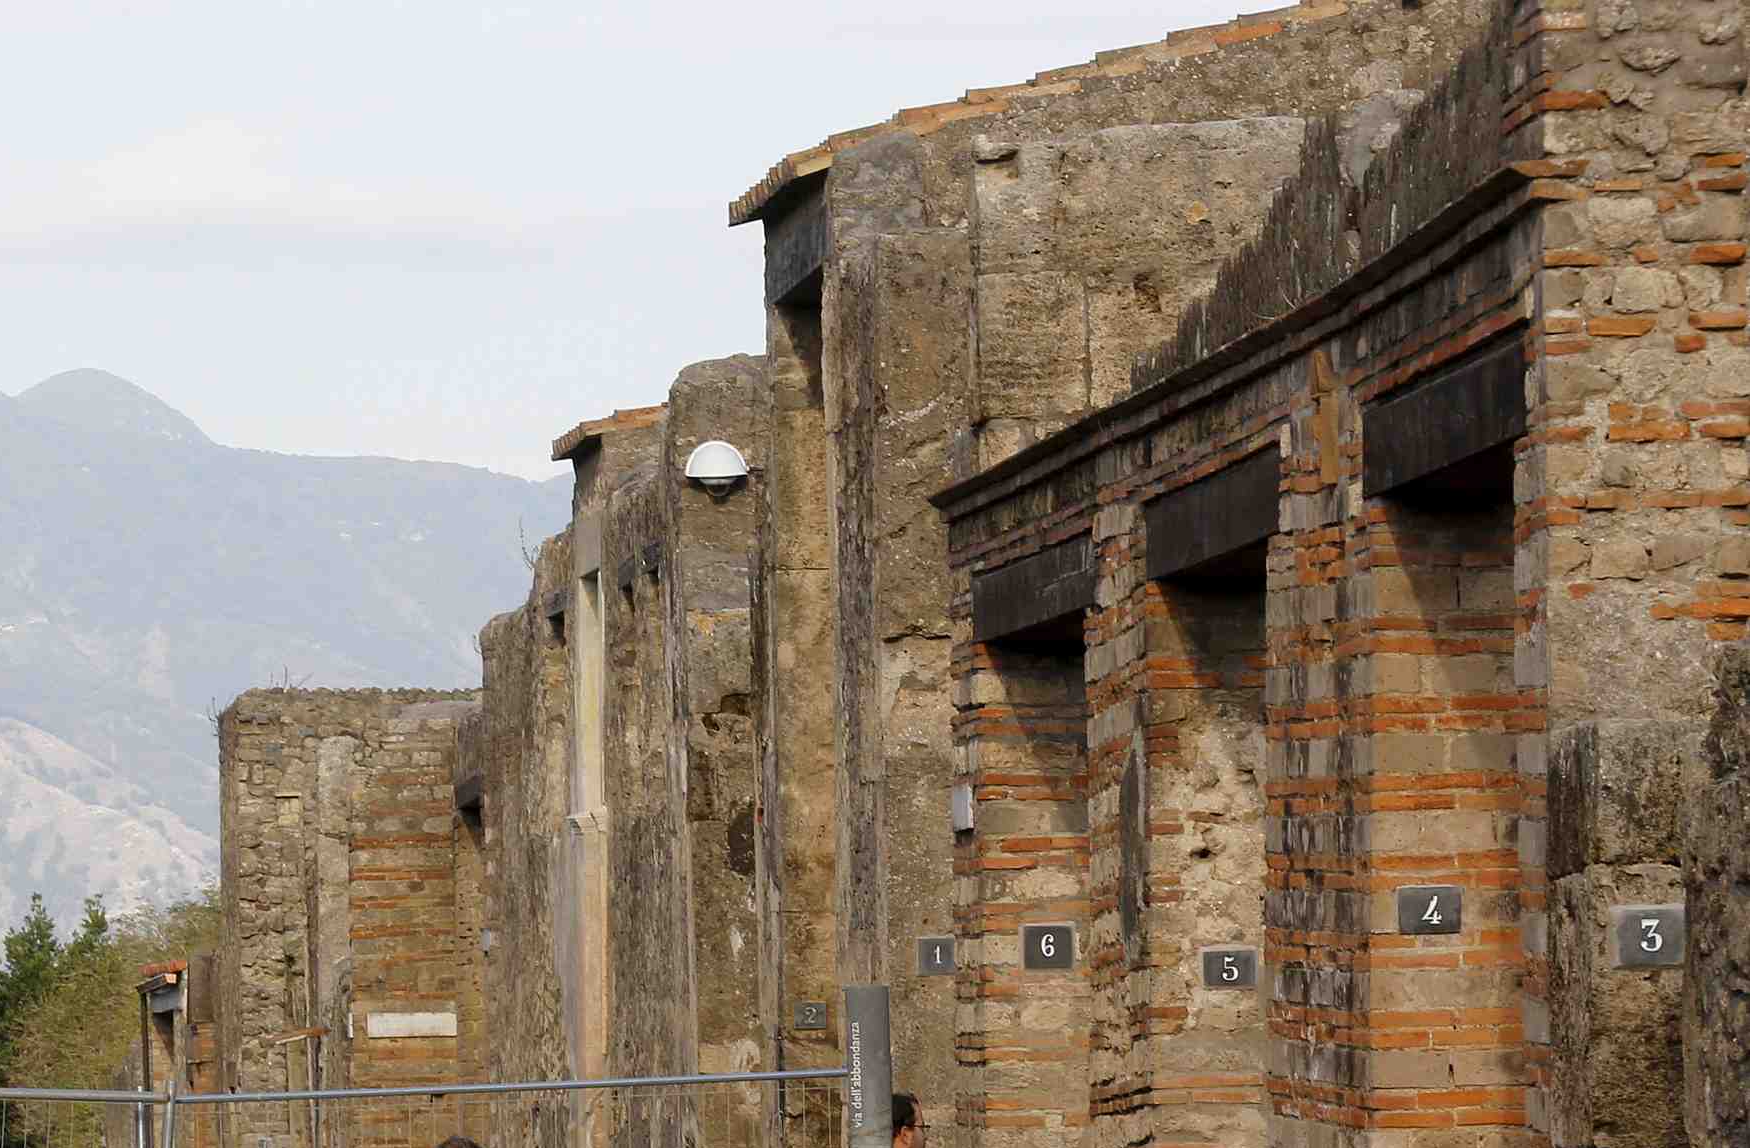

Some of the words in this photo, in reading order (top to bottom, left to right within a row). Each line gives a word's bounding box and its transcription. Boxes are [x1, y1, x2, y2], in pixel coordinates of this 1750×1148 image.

[1421, 896, 1443, 925] 4
[1041, 934, 1055, 957] 6
[1641, 918, 1663, 952] 3
[934, 945, 942, 964] 1
[1222, 956, 1239, 981] 5
[805, 1006, 817, 1024] 2
[850, 1022, 862, 1109] dell'abbondanza
[851, 1112, 863, 1128] via
